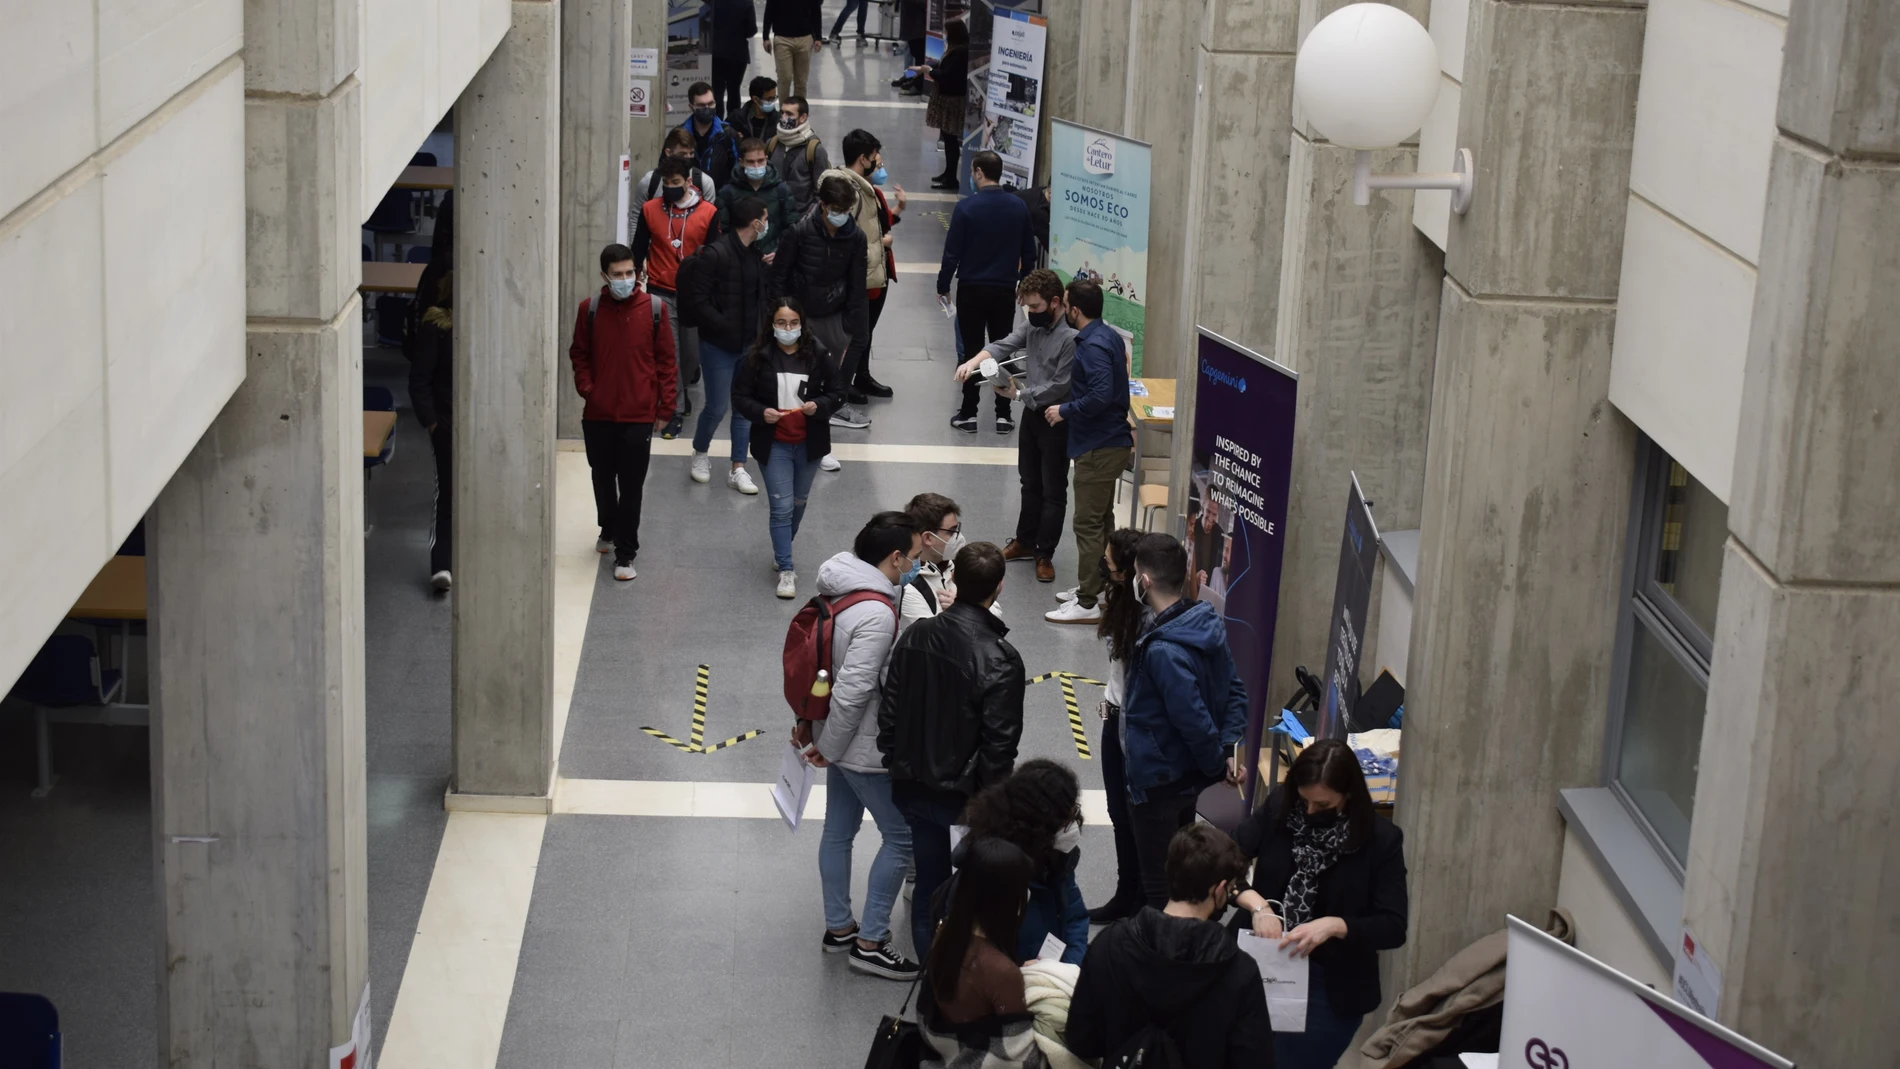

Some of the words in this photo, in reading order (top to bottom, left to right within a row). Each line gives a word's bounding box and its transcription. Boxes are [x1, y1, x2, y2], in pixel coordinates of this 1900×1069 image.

[998, 46, 1033, 63] INGENIERÍA
[1086, 145, 1113, 161] Cantero
[1090, 156, 1112, 171] Letur
[1065, 189, 1104, 211] SOMOS
[1107, 202, 1129, 219] ECO
[1082, 185, 1114, 200] NOSOTROS
[1069, 205, 1086, 215] DESDE
[1087, 210, 1100, 220] HACE
[1109, 217, 1123, 227] AÑOS
[1201, 358, 1238, 389] Capgemini
[1216, 435, 1249, 464] INSPIRED
[1251, 454, 1262, 469] BY
[1214, 452, 1230, 471] THE
[1231, 464, 1261, 489] CHANCE
[1213, 470, 1224, 486] TO
[1226, 477, 1265, 511] REIMAGINE
[1210, 488, 1238, 515] WHAT'S
[1239, 504, 1275, 536] POSSIBLE
